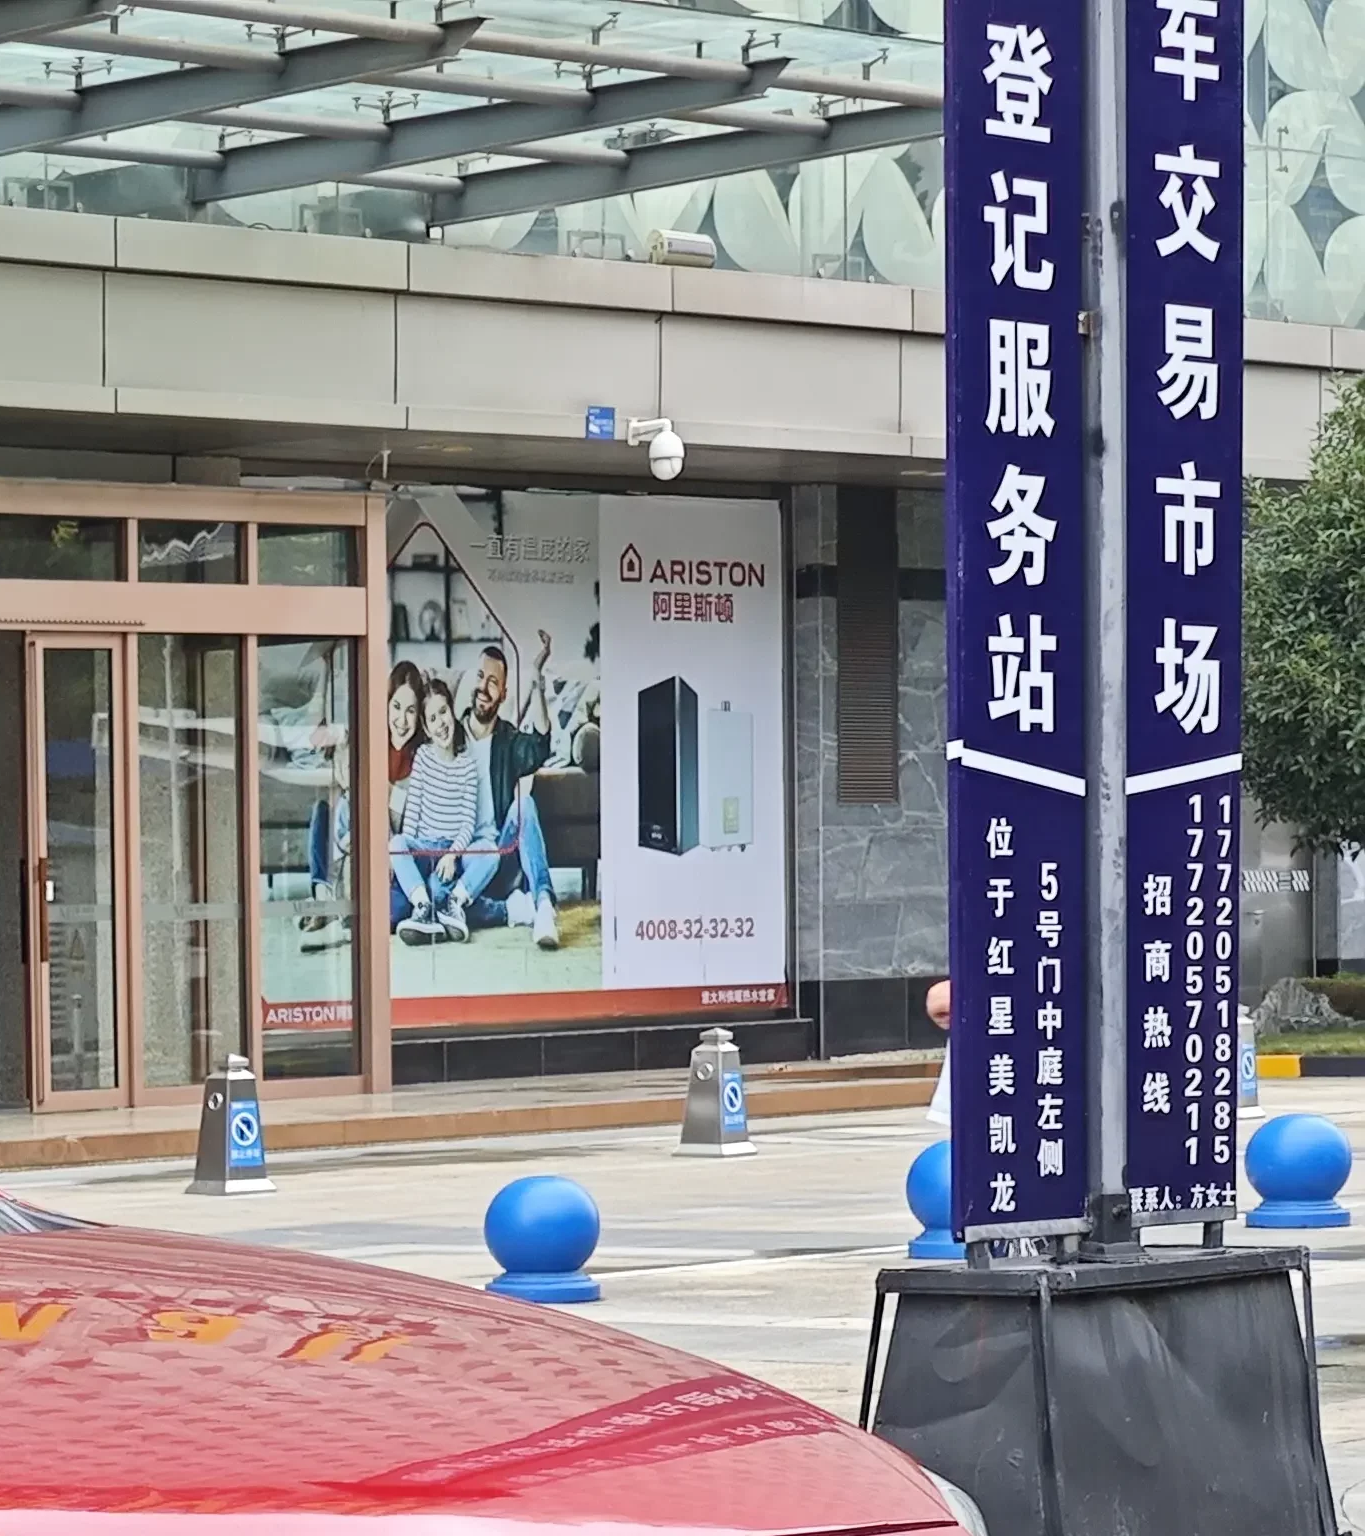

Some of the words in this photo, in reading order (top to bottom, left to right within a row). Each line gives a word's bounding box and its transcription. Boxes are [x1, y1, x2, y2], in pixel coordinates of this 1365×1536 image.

[982, 23, 1057, 733] 登记服务站
[1153, 0, 1221, 735] 车交易市场
[649, 559, 765, 587] ARISTON
[653, 591, 734, 623] 阿里斯顿
[266, 1006, 335, 1023] ARISTON
[635, 917, 755, 941] 4008-32-32-32
[986, 817, 1016, 1213] 位于红星美凯龙
[1035, 862, 1064, 1177] 5号门中庭左侧
[1142, 873, 1172, 1115] 招商热线
[1184, 794, 1204, 1165] 17720570211
[1213, 795, 1233, 1164] 17720518285
